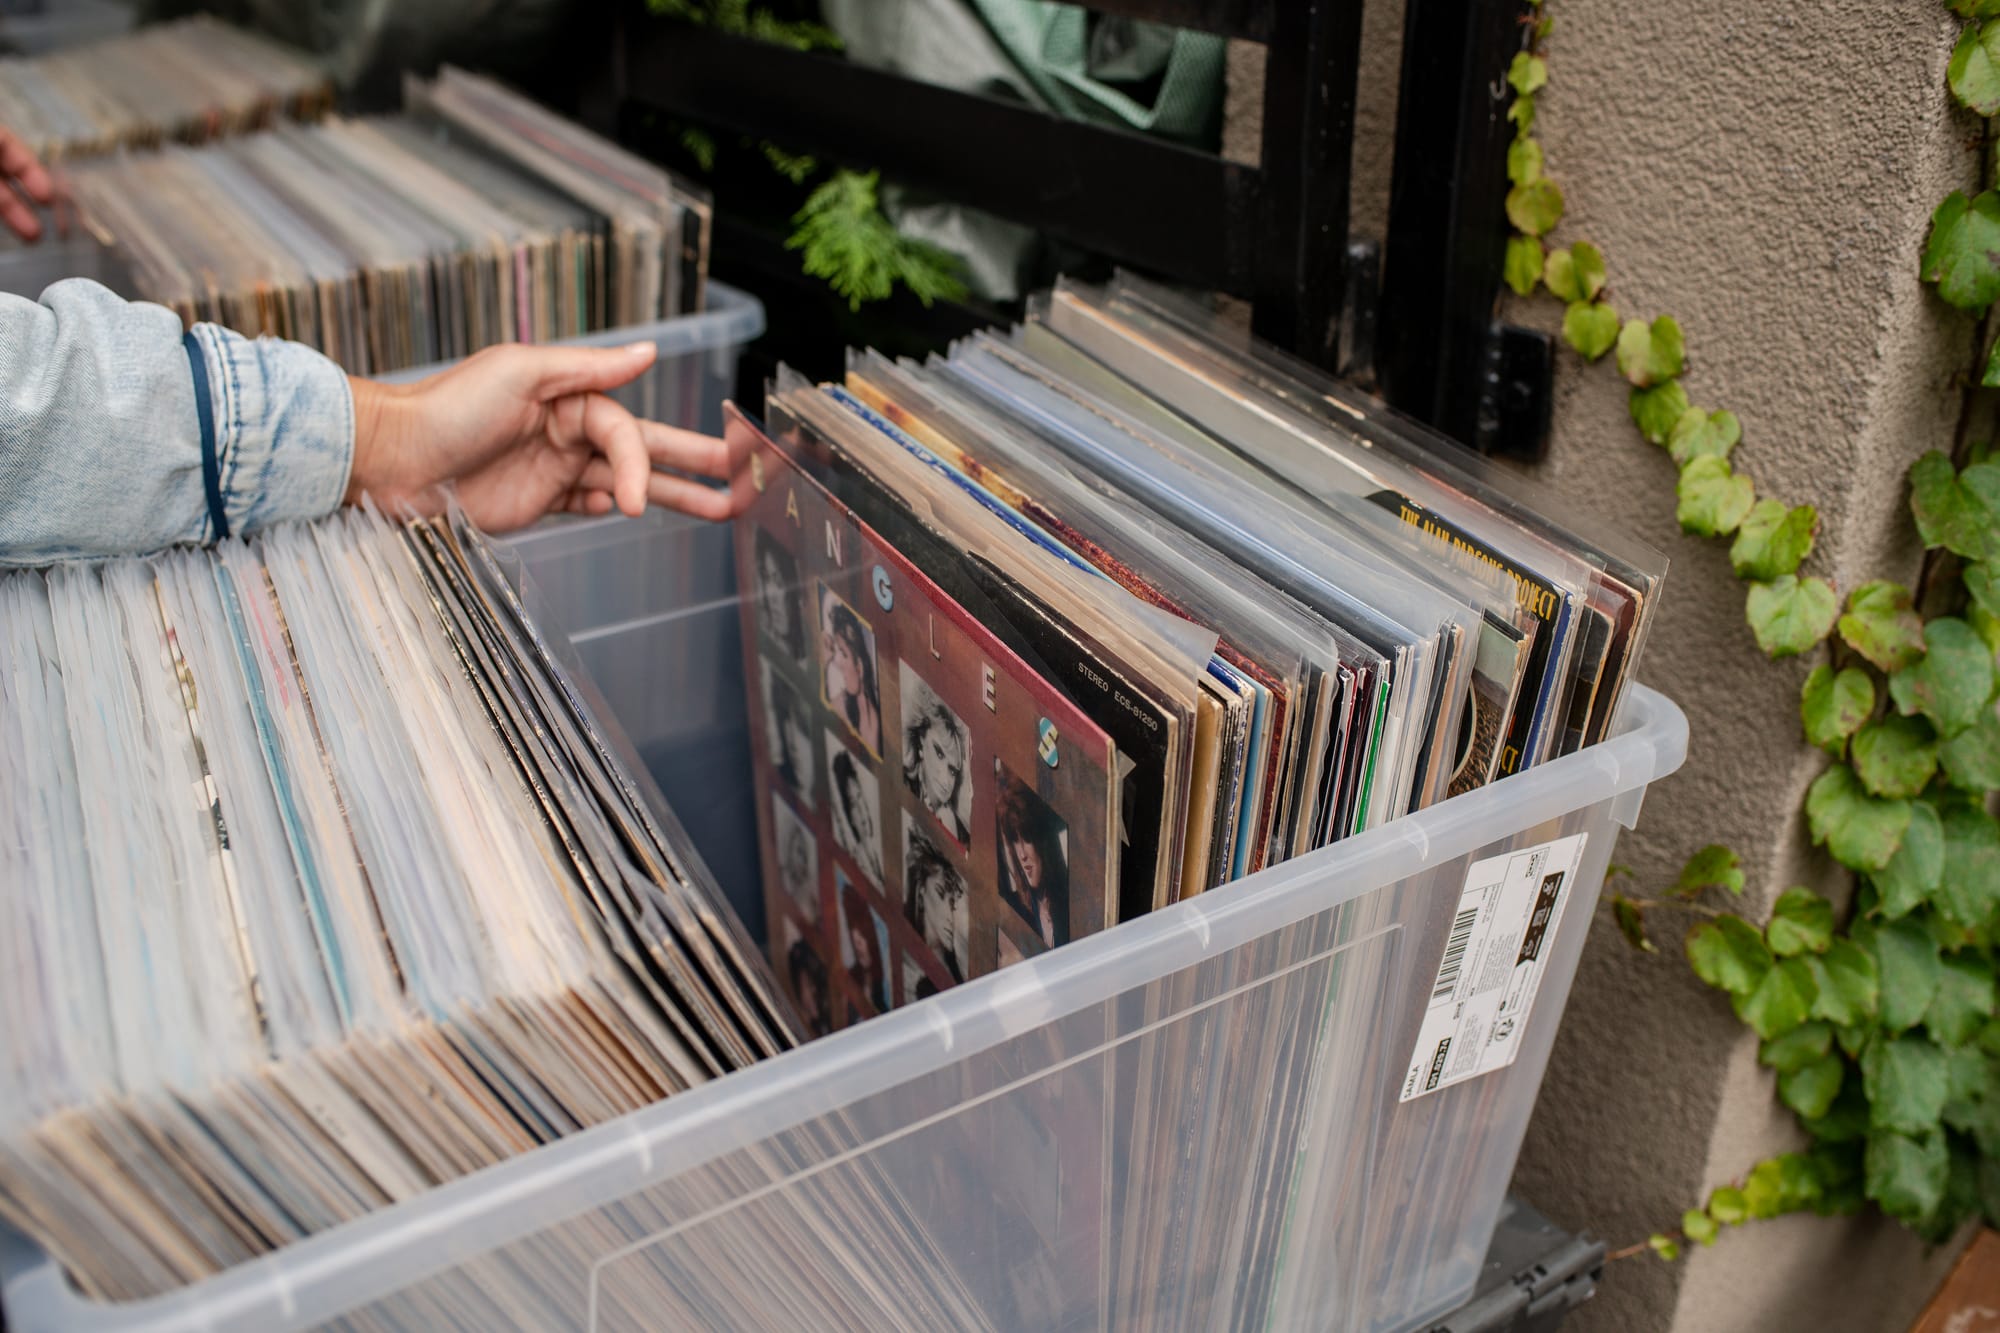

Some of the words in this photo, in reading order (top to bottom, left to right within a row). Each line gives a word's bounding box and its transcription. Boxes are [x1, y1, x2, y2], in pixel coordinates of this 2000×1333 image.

[1505, 568, 1557, 622] PROJECT
[1078, 662, 1109, 693] STEREO
[1114, 690, 1158, 731] ECS-81250
